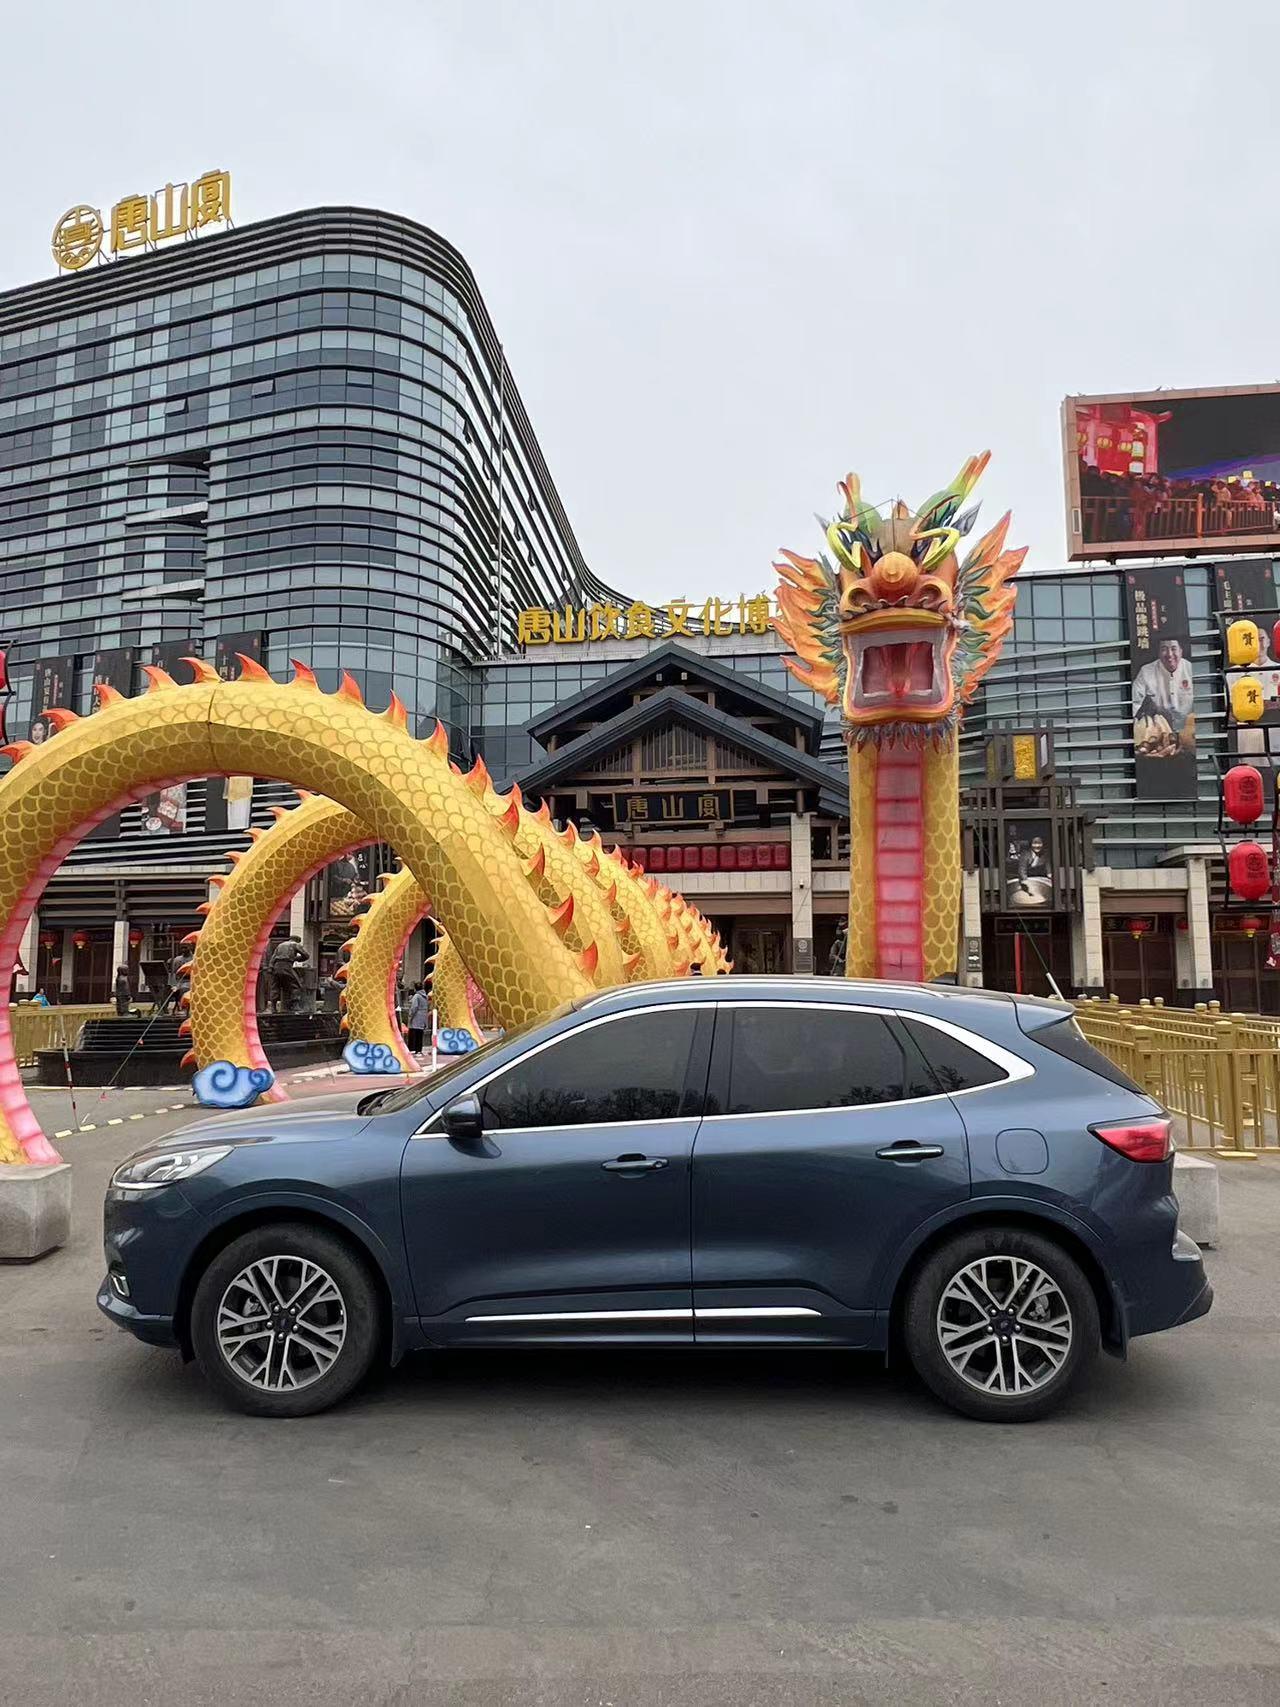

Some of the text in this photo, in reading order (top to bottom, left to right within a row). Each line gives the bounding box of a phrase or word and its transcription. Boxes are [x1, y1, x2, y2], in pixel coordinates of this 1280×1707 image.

[110, 169, 231, 254] 唐山宴
[518, 594, 786, 645] 唐山饮食文化博
[627, 793, 720, 820] 唐山宴
